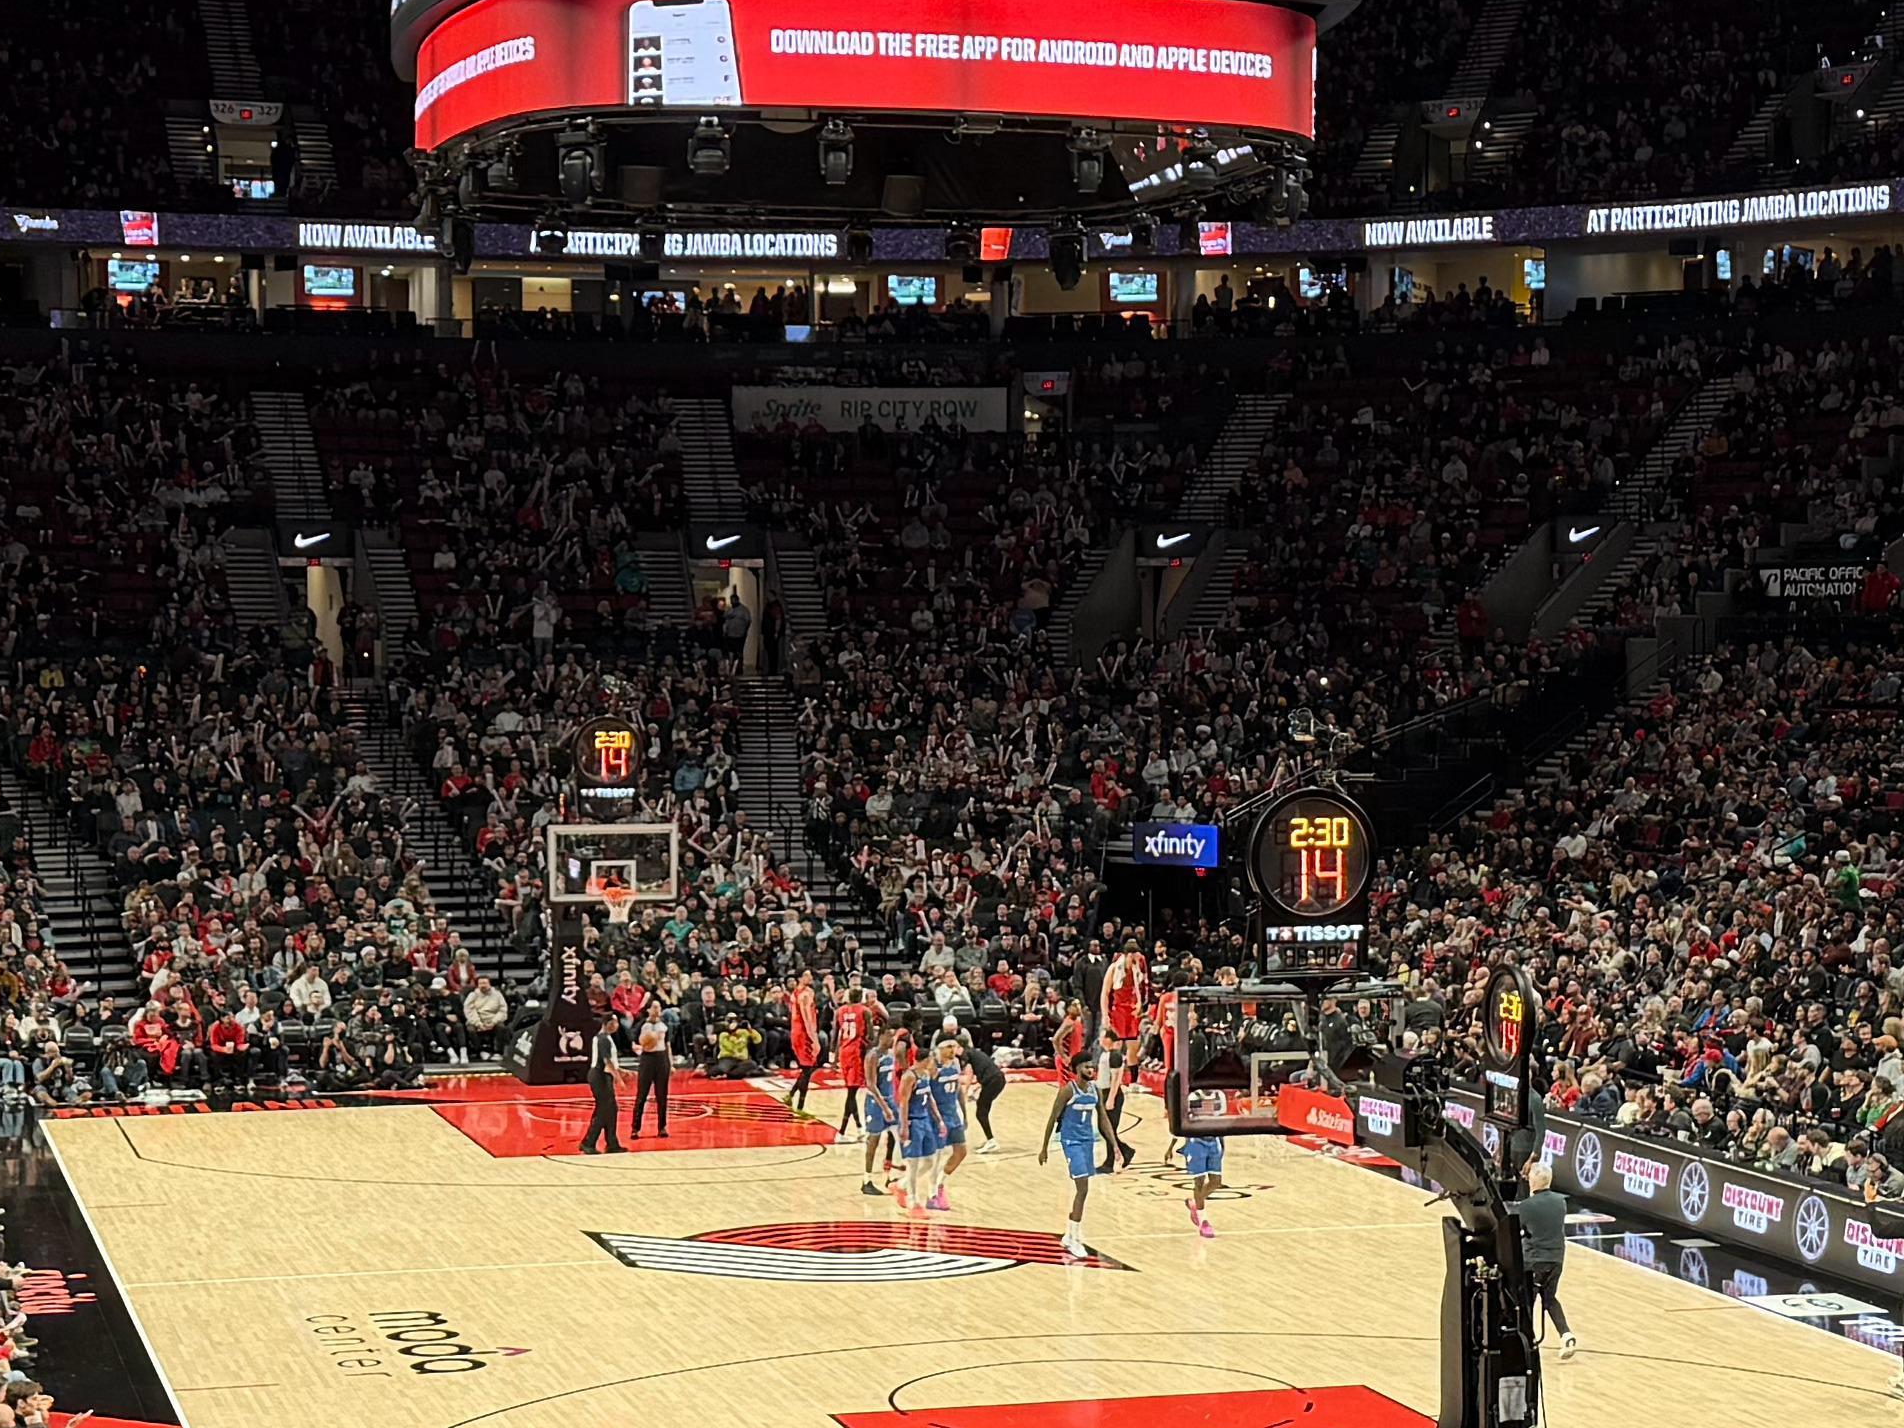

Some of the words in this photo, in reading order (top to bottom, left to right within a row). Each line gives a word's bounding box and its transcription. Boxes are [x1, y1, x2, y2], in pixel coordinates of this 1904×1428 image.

[770, 29, 874, 56] DOWNLOAD
[878, 32, 913, 58] THE
[915, 34, 960, 59] FREE
[962, 36, 997, 60] APP
[1001, 37, 1036, 62] FOR
[1038, 39, 1116, 67] ANDROID
[1119, 43, 1153, 69] AND
[1156, 46, 1207, 72] APPLE
[1210, 49, 1272, 79] DEVICES
[1587, 209, 1609, 233] AT
[1610, 199, 1739, 232] PARTICIPATING
[1742, 194, 1796, 222] JAMBA
[1798, 185, 1889, 217] LOCATIONS
[298, 221, 342, 250] NOW
[684, 233, 743, 257] JAMBA
[745, 233, 837, 257] LOCATIONS
[1364, 222, 1403, 247] NOW
[1404, 217, 1493, 246] AVAILABLE
[840, 401, 872, 418] RIP
[879, 400, 925, 418] CITY
[932, 401, 979, 418] ROW
[1784, 567, 1826, 581] PACIFIC
[601, 748, 626, 780] 14
[1145, 830, 1206, 858] xfinity
[1290, 818, 1349, 847] 2:30
[1301, 849, 1343, 900] 14
[1296, 925, 1364, 941] TISSOT
[562, 946, 580, 1004] xfinity
[1612, 1151, 1670, 1188] DISCOUNT
[1625, 1174, 1655, 1196] TIRE
[1722, 1182, 1784, 1222] DISCOUNT
[1734, 1209, 1766, 1232] TIRE
[1858, 1247, 1896, 1273] TIRE
[305, 1313, 393, 1378] center
